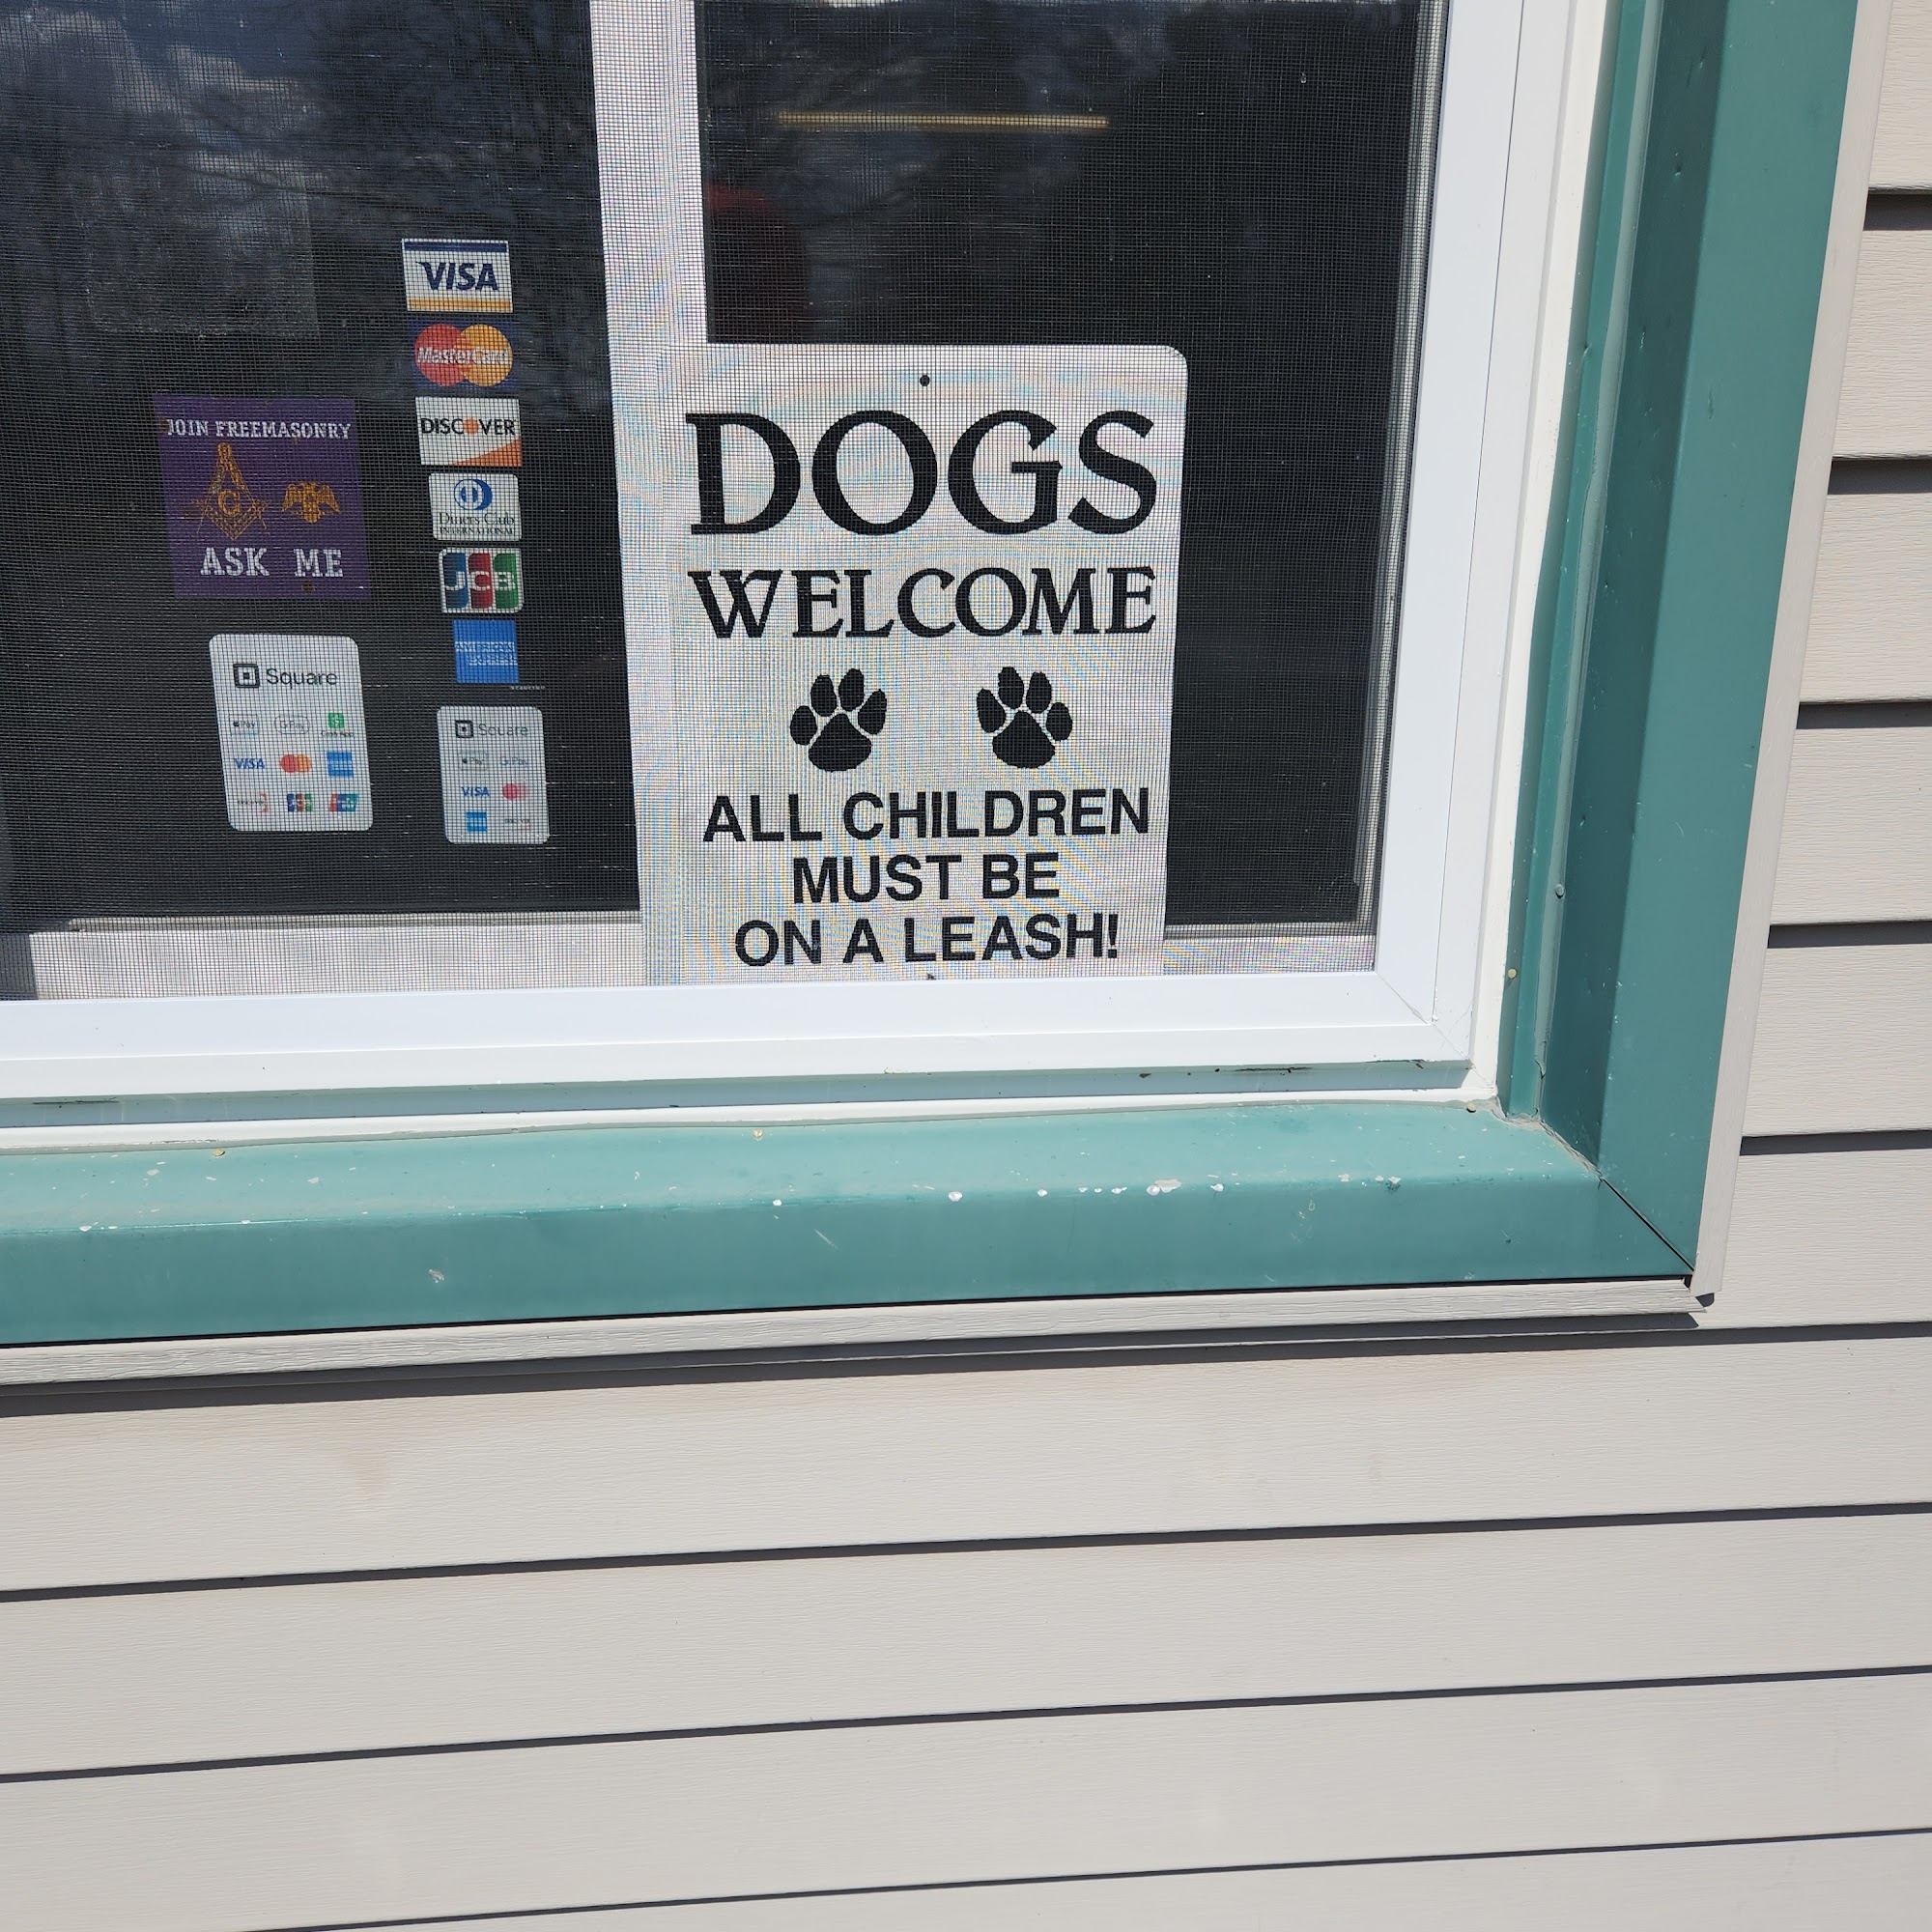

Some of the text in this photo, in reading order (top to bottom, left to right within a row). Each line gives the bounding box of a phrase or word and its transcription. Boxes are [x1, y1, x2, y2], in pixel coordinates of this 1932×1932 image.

[415, 261, 499, 291] VISA
[416, 346, 510, 365] MasterCard
[166, 418, 352, 440] JOIN FREEMASONRY
[420, 417, 516, 435] DISCOVER
[685, 410, 1157, 536] DOGS
[200, 547, 343, 578] ASK ME
[444, 571, 516, 590] JCB
[687, 566, 1156, 639] WELCOME
[266, 668, 338, 690] Square
[478, 723, 529, 737] Square
[233, 756, 266, 770] VISA
[462, 786, 491, 798] VISA
[702, 788, 1149, 842] ALL CHILDREN
[793, 852, 1060, 904] MUST BE
[734, 913, 1118, 966] ON A LEASH!
